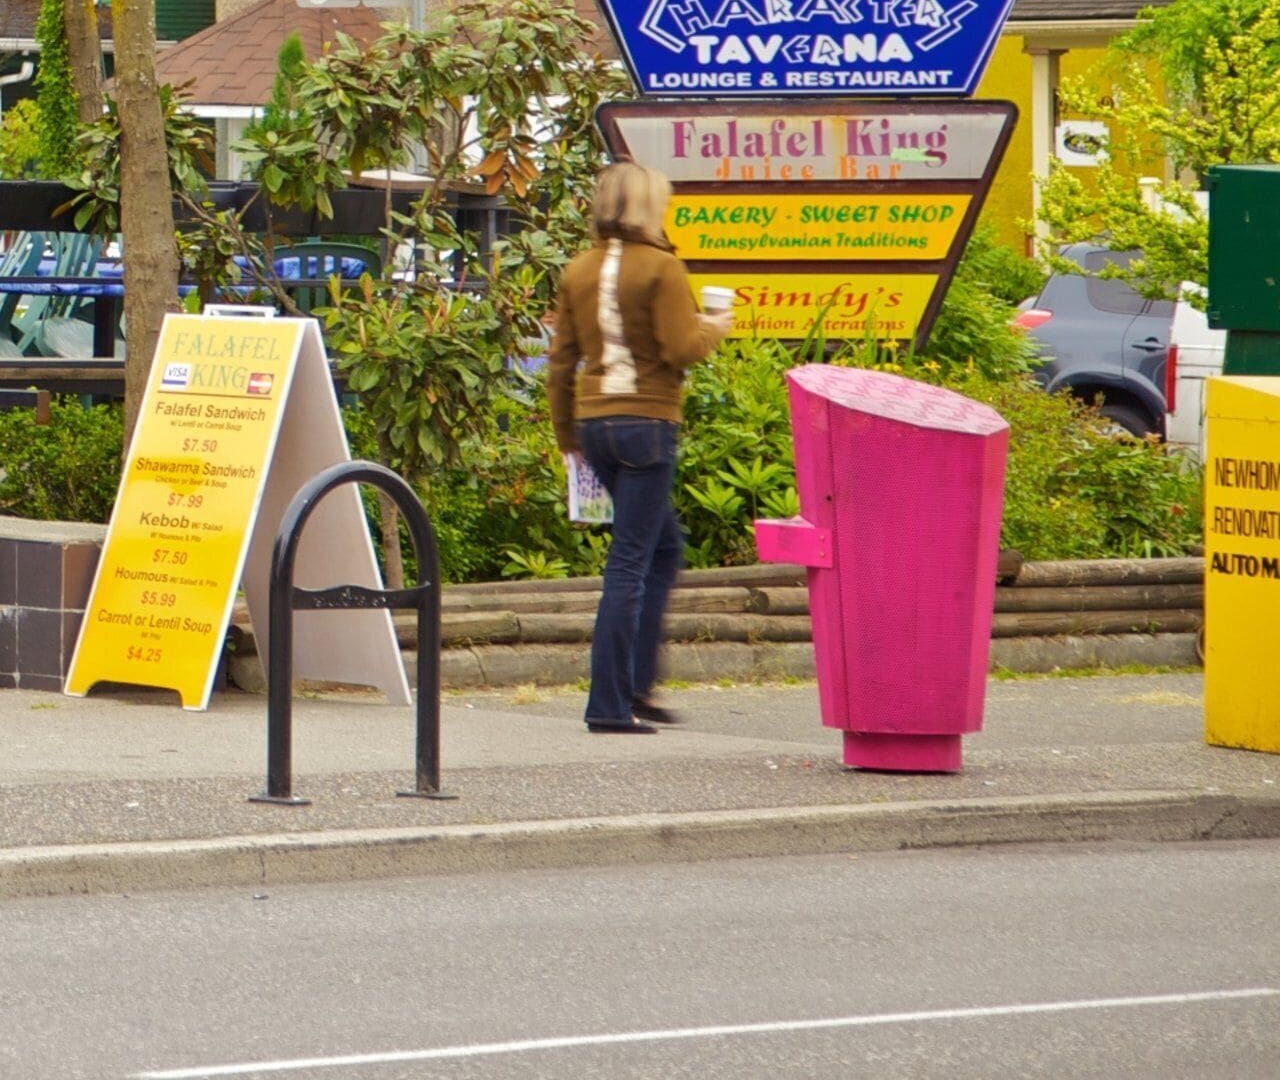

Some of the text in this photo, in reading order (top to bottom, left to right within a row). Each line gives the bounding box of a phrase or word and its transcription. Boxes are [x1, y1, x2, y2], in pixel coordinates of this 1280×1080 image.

[689, 33, 913, 66] TAVERNA
[650, 71, 952, 88] LOUNGE & RESTAURANT
[672, 119, 947, 167] Falafel King
[715, 156, 902, 181] Juice Bar
[674, 206, 778, 228] BAKERY
[800, 205, 879, 225] SWEET
[887, 205, 955, 223] SHOP
[698, 233, 928, 250] Transylvanian Traditions
[733, 282, 903, 317] Simdy's
[735, 314, 795, 331] ashion
[173, 331, 279, 360] FALAFEL
[168, 367, 188, 377] VISA
[191, 363, 248, 389] KING
[155, 401, 266, 421] Falafel Sandwich
[183, 438, 217, 452] $7.50
[136, 457, 256, 478] Shawarma Sandwich
[168, 492, 203, 507] $7.99
[140, 512, 189, 528] Kebob
[153, 549, 188, 565] $7.50
[1211, 552, 1259, 577] AUTO
[115, 567, 168, 582] Houmous
[141, 591, 176, 607] $5.99
[98, 609, 212, 635] Carrot or Lentil Soup
[126, 646, 162, 662] $4.25
